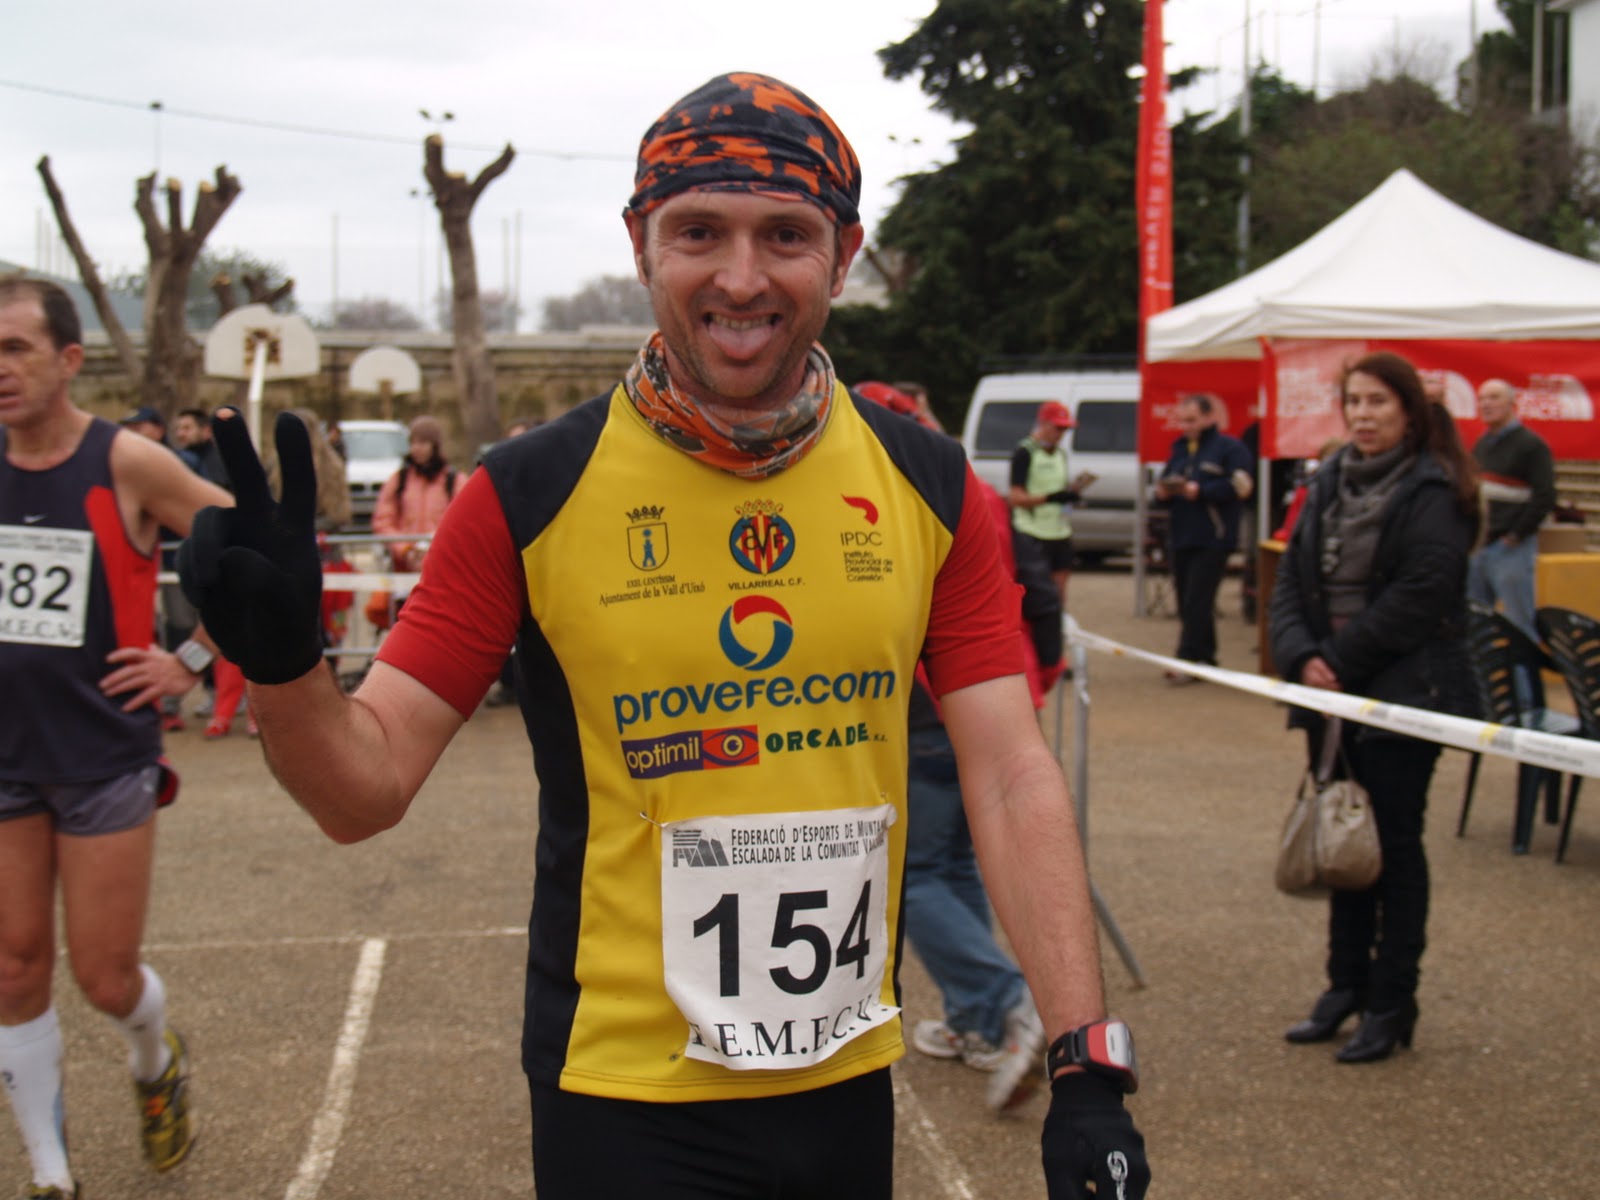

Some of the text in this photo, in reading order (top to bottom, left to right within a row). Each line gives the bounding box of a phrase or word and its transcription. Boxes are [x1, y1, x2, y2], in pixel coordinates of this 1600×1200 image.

[841, 531, 882, 546] IPDC
[0, 561, 72, 611] 82
[599, 591, 641, 607] Ajuntament
[642, 588, 652, 598] de
[653, 586, 661, 597] la
[662, 584, 678, 595] Vall
[728, 579, 785, 590] VILLARREAL
[765, 722, 868, 753] ORCADE
[626, 737, 700, 774] optimil
[845, 823, 853, 839] DE
[732, 846, 781, 865] ESCALADA
[784, 846, 796, 862] DE
[801, 844, 812, 861] LA
[693, 878, 872, 998] 154
